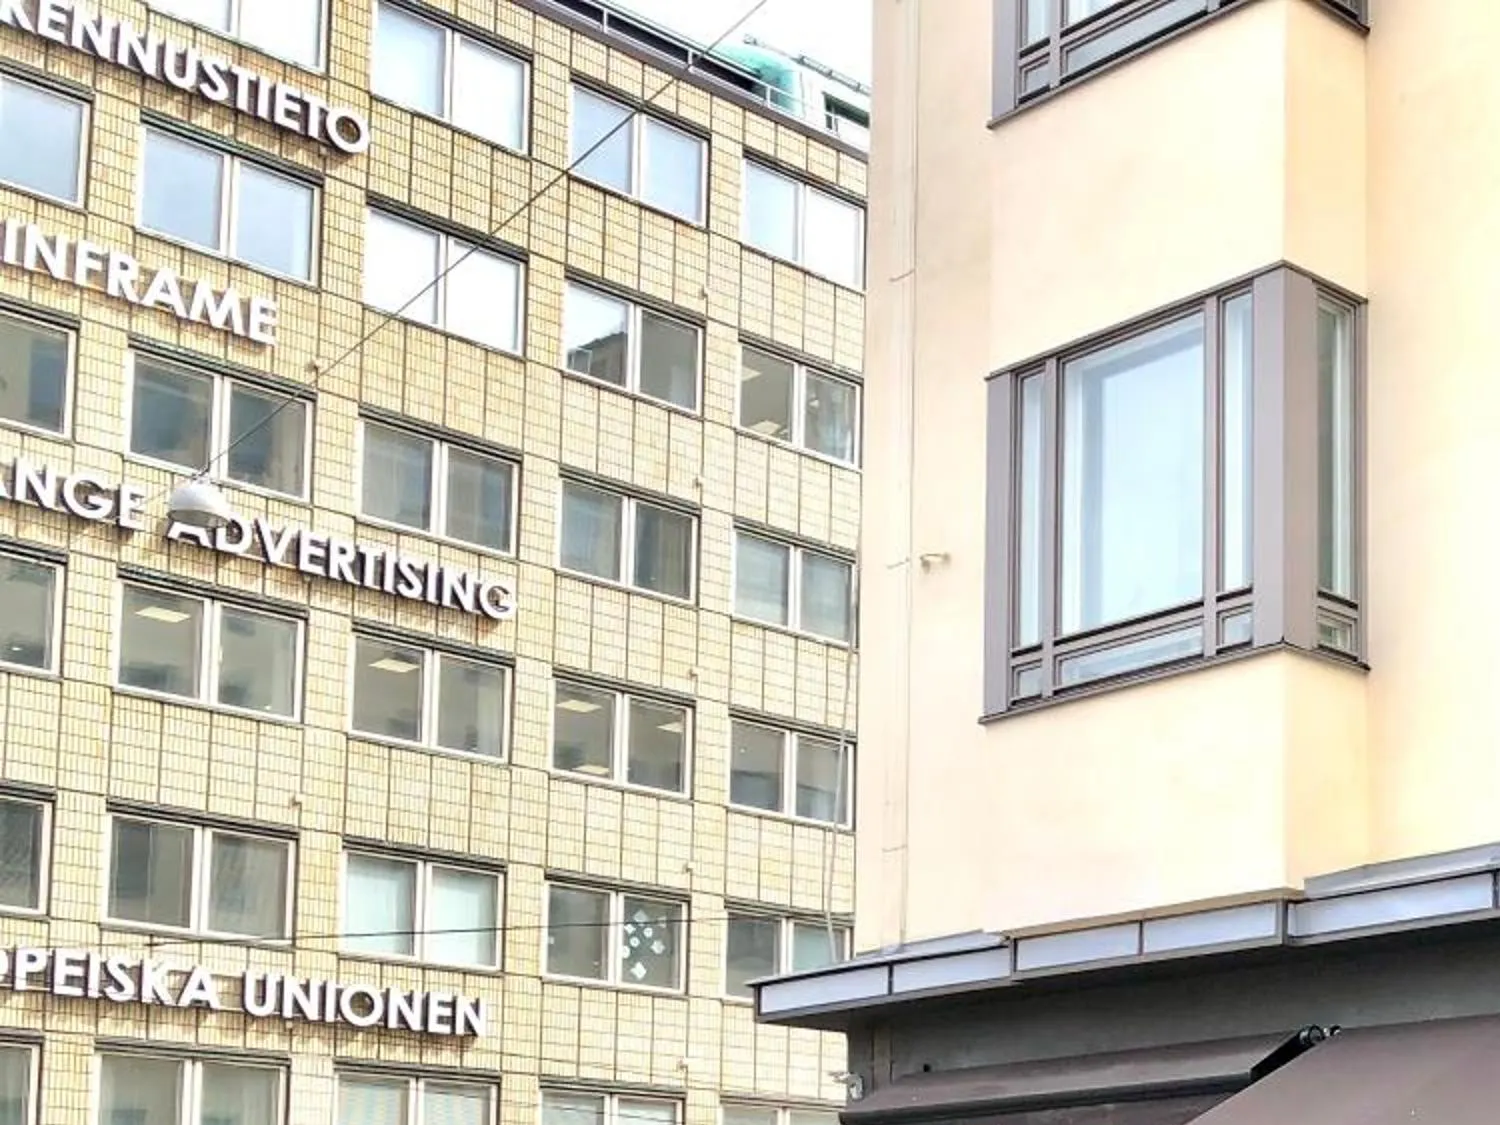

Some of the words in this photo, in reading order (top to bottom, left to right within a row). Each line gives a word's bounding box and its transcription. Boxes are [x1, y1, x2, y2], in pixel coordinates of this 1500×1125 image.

[2, 218, 277, 346] INFRAME
[0, 457, 147, 531] NGE
[0, 946, 222, 1008] PEISKA
[242, 969, 489, 1037] UNIONEN
